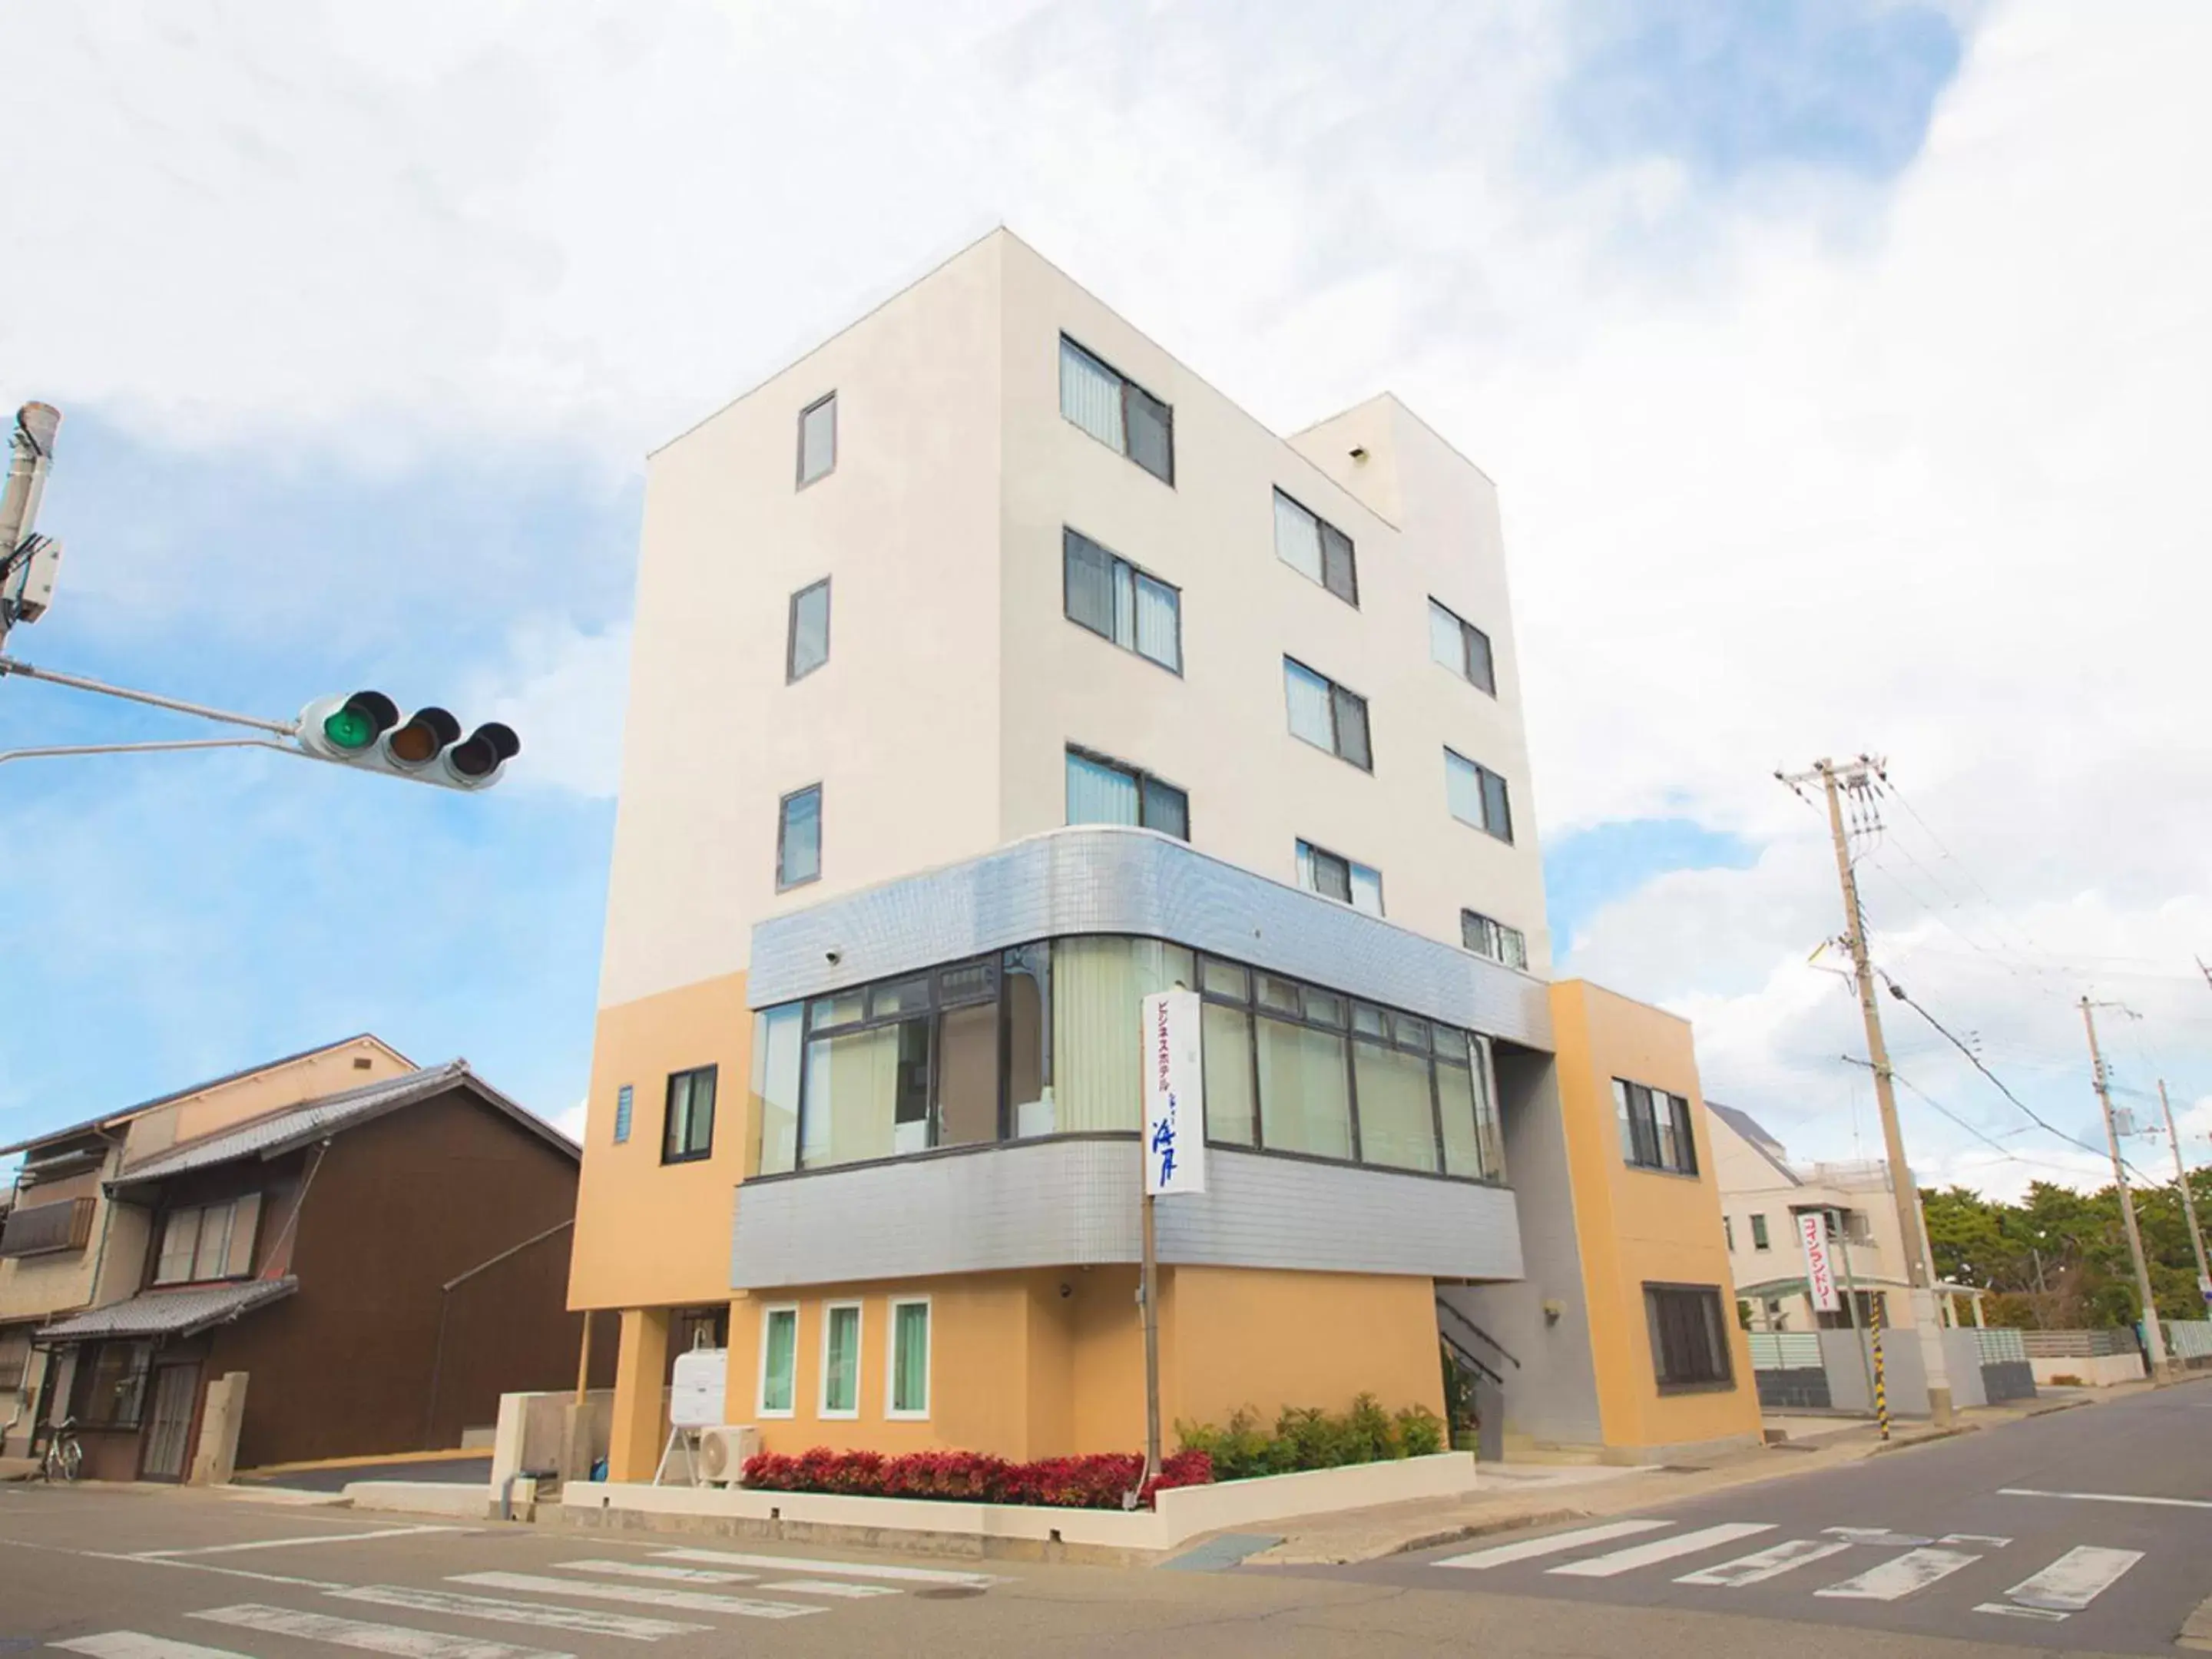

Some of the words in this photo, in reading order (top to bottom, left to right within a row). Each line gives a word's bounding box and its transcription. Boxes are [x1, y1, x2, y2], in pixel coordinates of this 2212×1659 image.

[1158, 1002, 1169, 1091] ビジネスホテル
[1804, 1218, 1830, 1307] コインランドリー
